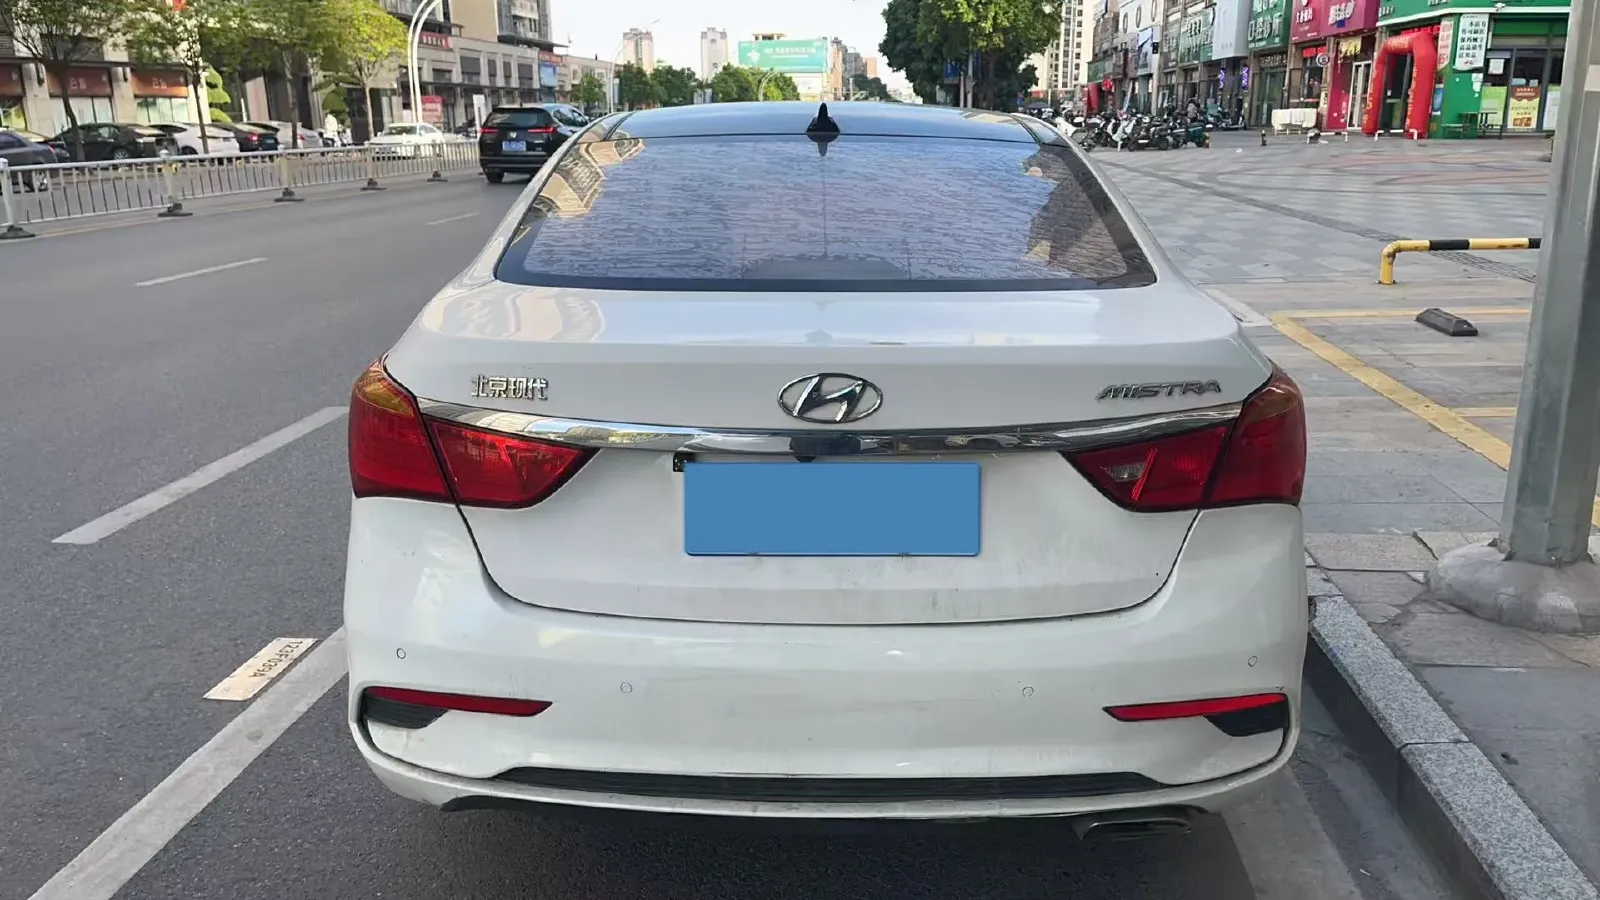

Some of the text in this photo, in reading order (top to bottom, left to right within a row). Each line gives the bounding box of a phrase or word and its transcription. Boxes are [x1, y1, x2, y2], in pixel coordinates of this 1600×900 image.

[470, 374, 548, 401] 北京现代
[1096, 380, 1222, 400] MISTRA
[248, 640, 304, 677] 123F039A
